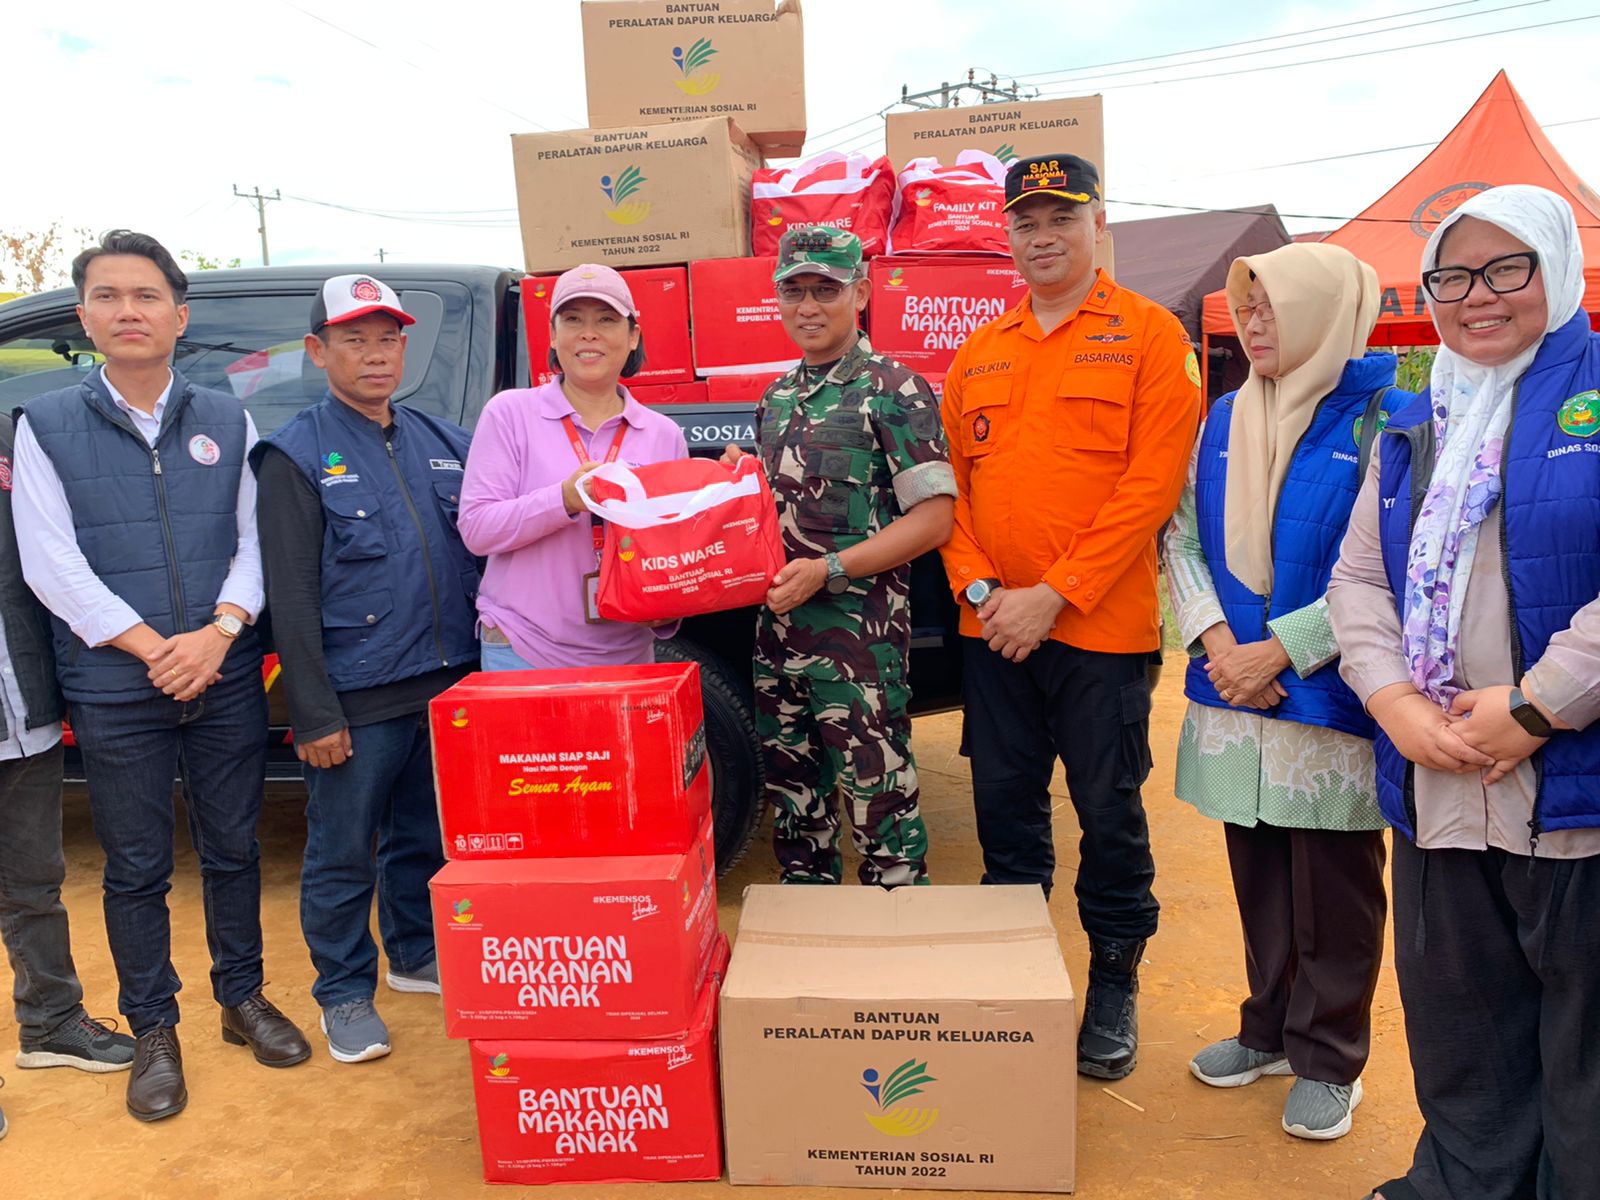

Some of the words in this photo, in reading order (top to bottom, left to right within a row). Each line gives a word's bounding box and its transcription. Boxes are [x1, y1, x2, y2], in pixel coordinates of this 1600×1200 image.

[666, 3, 720, 13] BANTUAN
[609, 16, 674, 28] PERALATAN
[677, 15, 715, 25] DAPUR
[718, 12, 778, 24] KELUARGA
[639, 104, 708, 115] KEMENTERIAN
[710, 103, 744, 112] SOSIAL
[747, 103, 757, 111] RI
[968, 111, 1022, 124] BANTUAN
[913, 126, 977, 140] PERALATAN
[979, 123, 1017, 136] DAPUR
[1019, 117, 1079, 132] KELUARGA
[594, 131, 648, 143] BANTUAN
[537, 145, 601, 160] PERALATAN
[604, 143, 643, 154] DAPUR
[645, 136, 708, 151] KELUARGA
[1029, 160, 1059, 174] SAR
[933, 202, 975, 212] FAMILY
[978, 201, 997, 211] KIT
[571, 235, 640, 248] KEMENTERIAN
[642, 232, 677, 244] SOSIAL
[680, 231, 690, 241] RI
[602, 245, 635, 256] TAHUN
[638, 244, 660, 255] 2022
[736, 306, 779, 314] KEMENTRIA
[905, 295, 1005, 315] BANTUAN
[901, 314, 1002, 332] MAKANA
[923, 332, 968, 349] ANA
[1074, 352, 1134, 366] BASARNAS
[963, 361, 1011, 379] MUSLIKUN
[690, 425, 756, 442] SOSIA
[1332, 451, 1358, 463] DINAS
[1547, 443, 1582, 459] DINAS
[1584, 443, 1600, 453] SO
[641, 555, 679, 571] KIDS
[680, 541, 726, 568] WARE
[642, 577, 697, 593] KEMENTERIAN
[698, 569, 723, 583] SOSIAL
[668, 567, 705, 582] BANTUAN
[499, 753, 556, 764] MAKANAN
[559, 752, 584, 762] SIAP
[585, 751, 611, 761] SAJI
[560, 765, 588, 773] Dengan
[508, 777, 560, 796] Semur
[563, 775, 613, 797] Ayam
[454, 839, 466, 849] 10
[593, 895, 651, 903] #KEMENSOS
[482, 935, 627, 960] BANTUAN
[480, 960, 633, 984] MAKANAN
[517, 984, 600, 1008] ANAK
[853, 1011, 940, 1025] BANTUAN
[763, 1027, 866, 1041] PERALATAN
[871, 1029, 931, 1042] DAPUR
[936, 1030, 1034, 1043] KELUARGA
[628, 1045, 685, 1056] #KEMENSOS
[518, 1083, 663, 1112] BANTUAN
[518, 1107, 669, 1135] MAKANAN
[555, 1130, 638, 1154] ANAK
[807, 1149, 915, 1163] KEMENTERIAN
[919, 1152, 975, 1164] SOSIAL
[979, 1153, 994, 1164] RI
[855, 1165, 908, 1176] TAHUN
[911, 1166, 947, 1177] 2022
